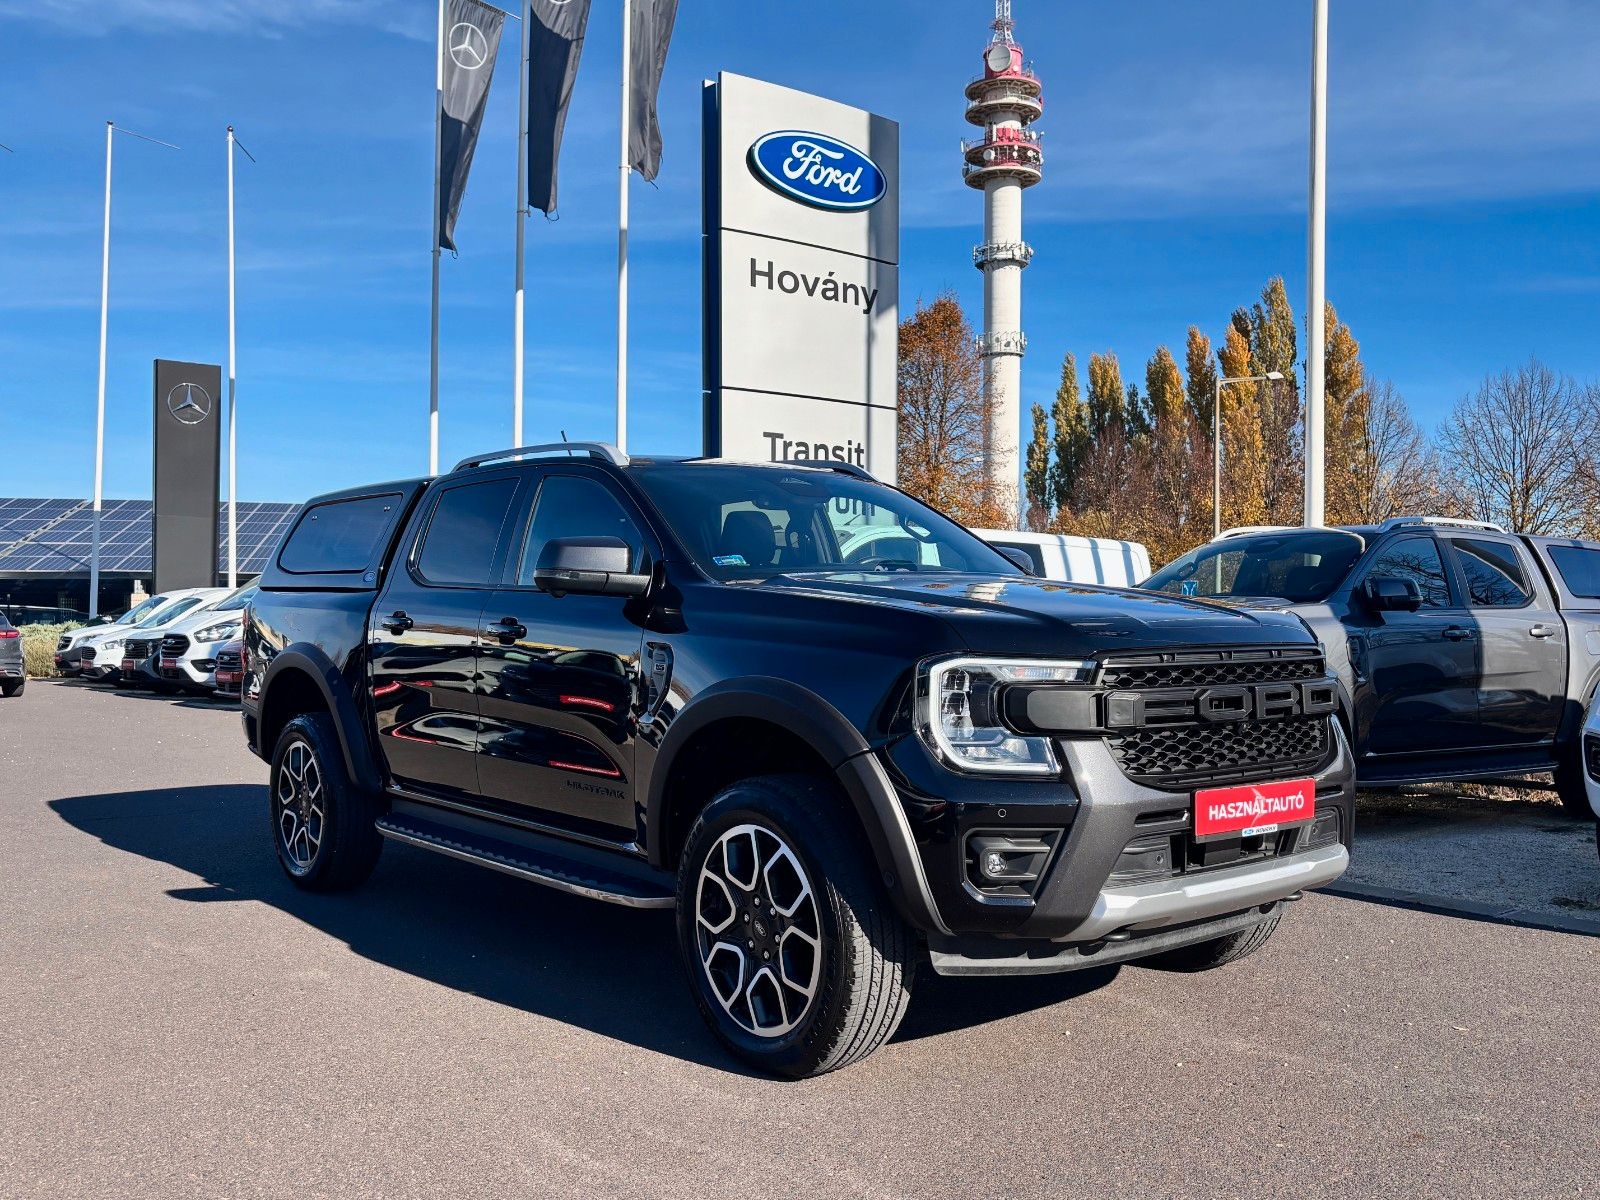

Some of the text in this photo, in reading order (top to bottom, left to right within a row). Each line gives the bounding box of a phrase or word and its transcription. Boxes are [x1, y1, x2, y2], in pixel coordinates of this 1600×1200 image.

[782, 140, 864, 195] Ford
[750, 257, 878, 315] Hovány
[763, 431, 865, 469] Transit
[1131, 680, 1340, 728] FORD
[1208, 790, 1305, 821] HASZNÁLTAUTÓ
